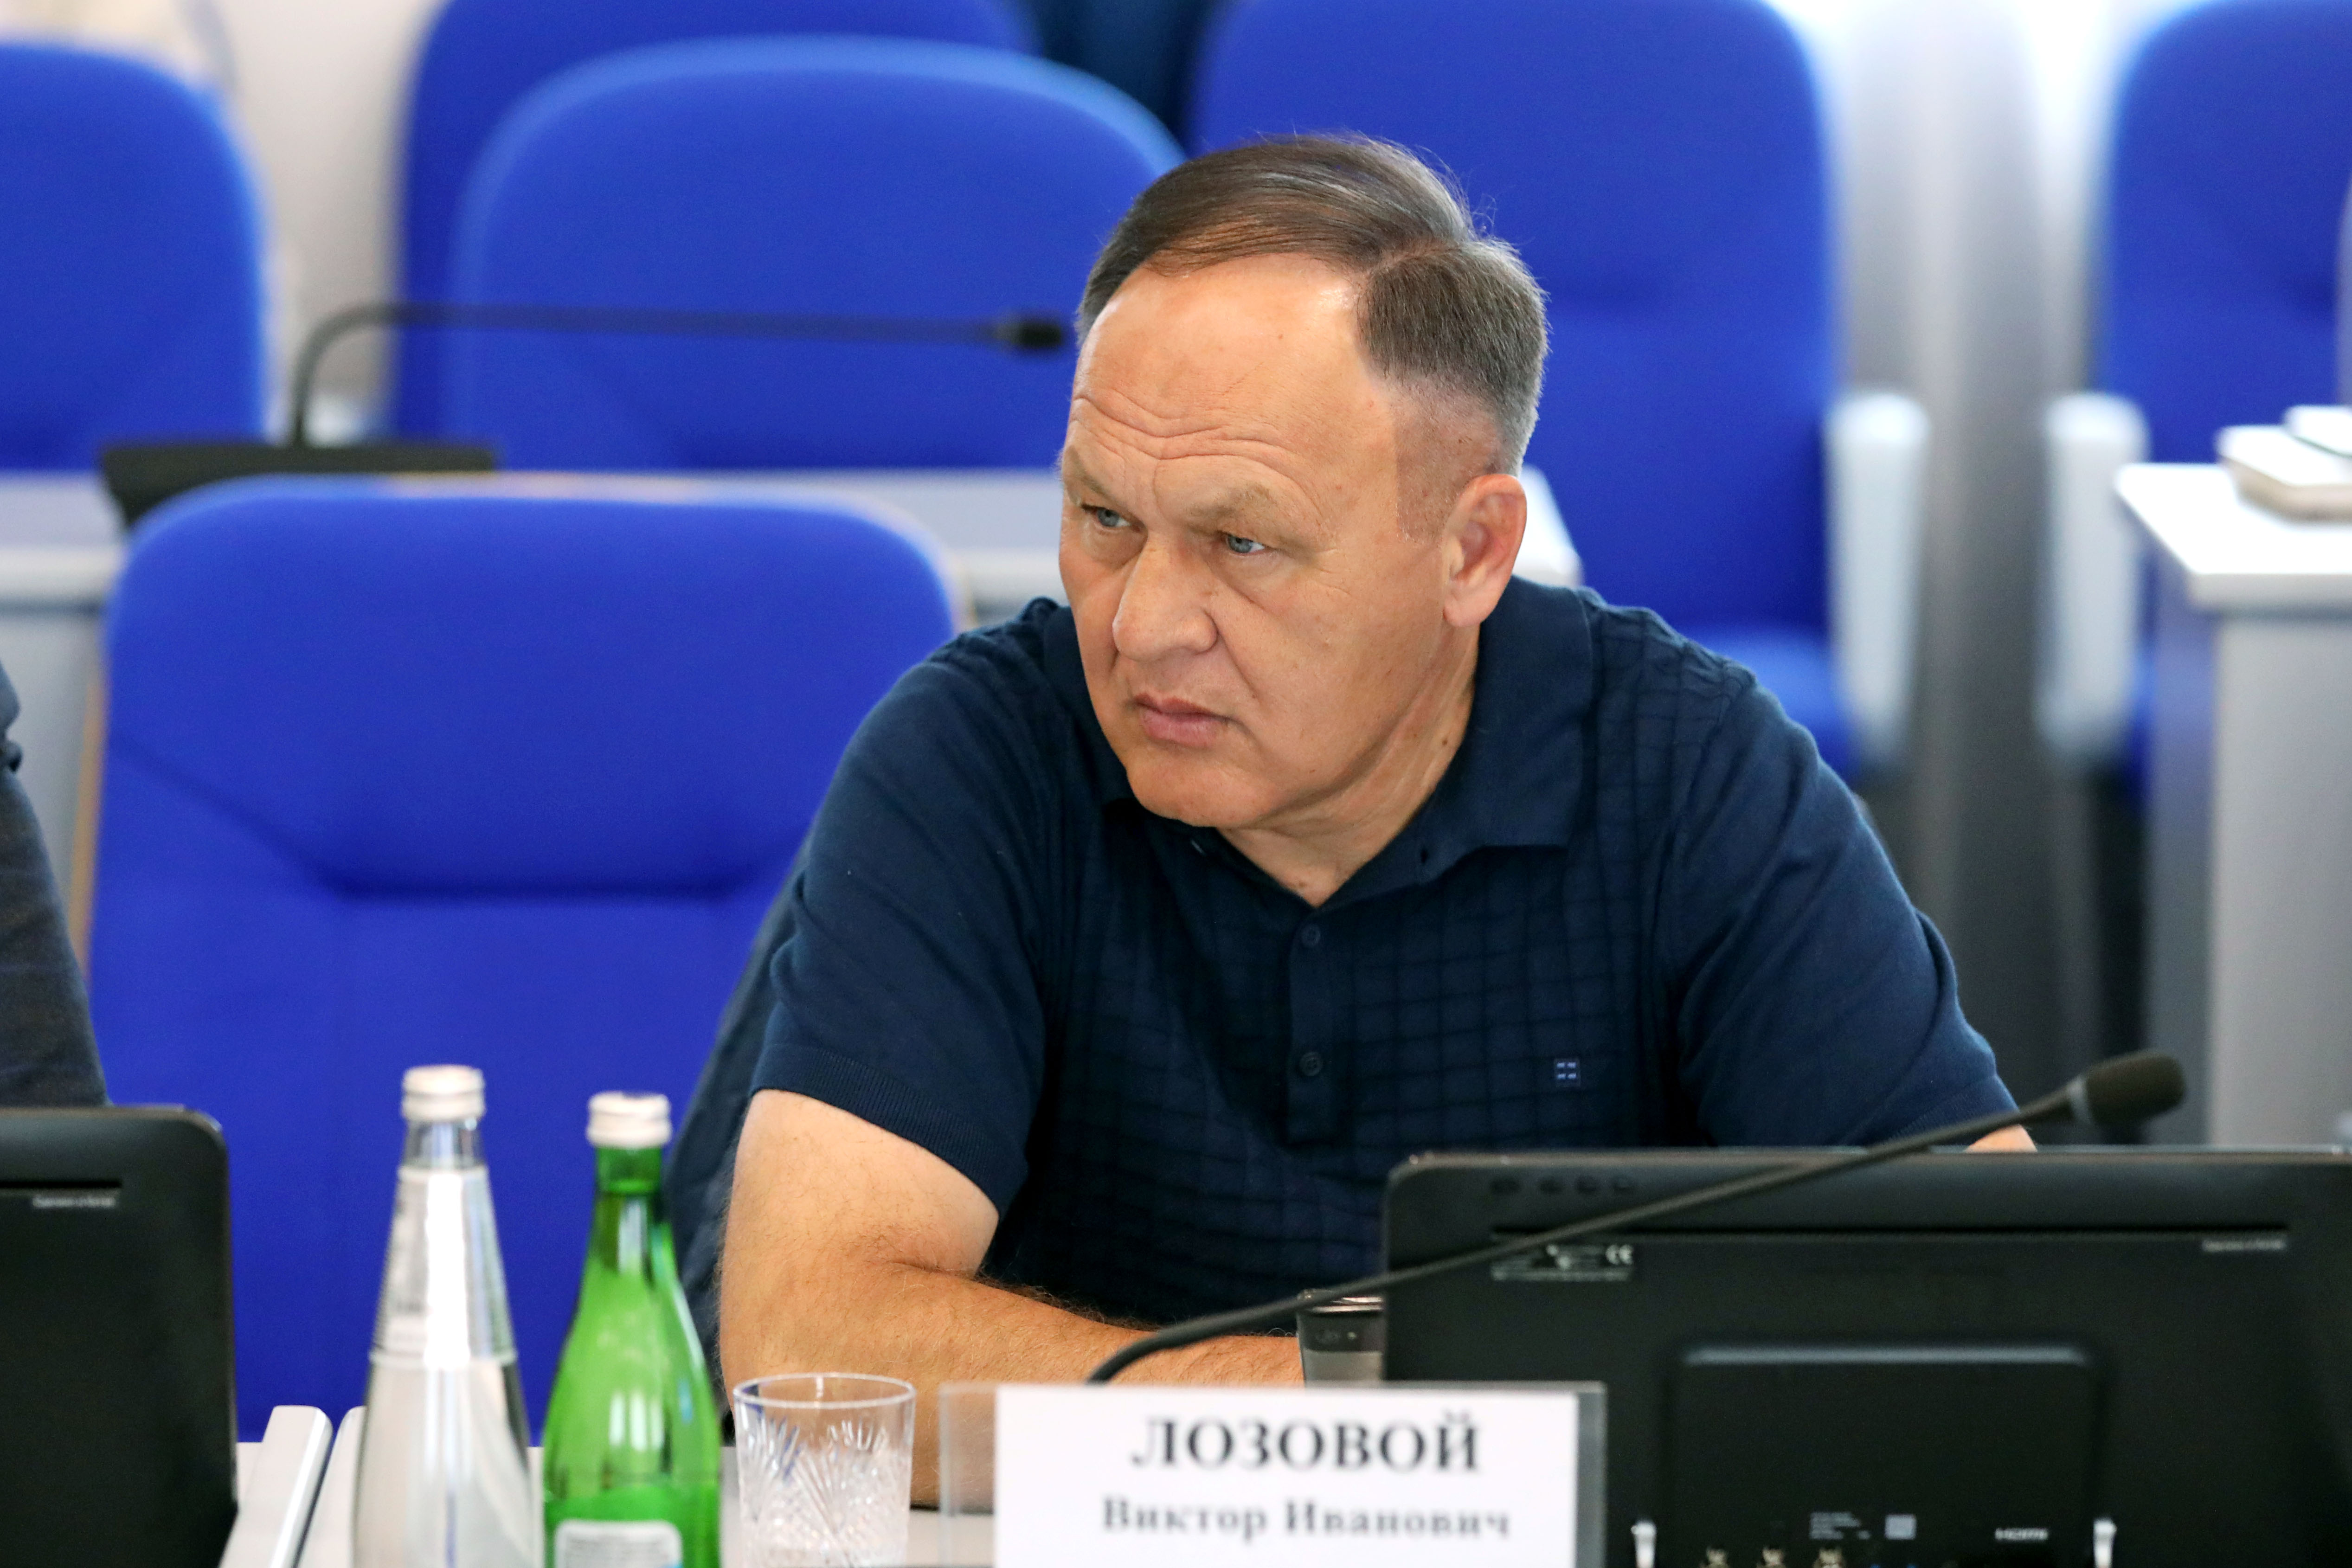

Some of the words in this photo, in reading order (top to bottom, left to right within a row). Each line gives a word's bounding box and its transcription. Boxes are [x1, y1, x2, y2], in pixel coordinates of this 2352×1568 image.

[1131, 1412, 1479, 1472] ЛОЗОВОЙ
[1103, 1497, 1267, 1542] Виктор
[1285, 1500, 1509, 1537] Иванович
